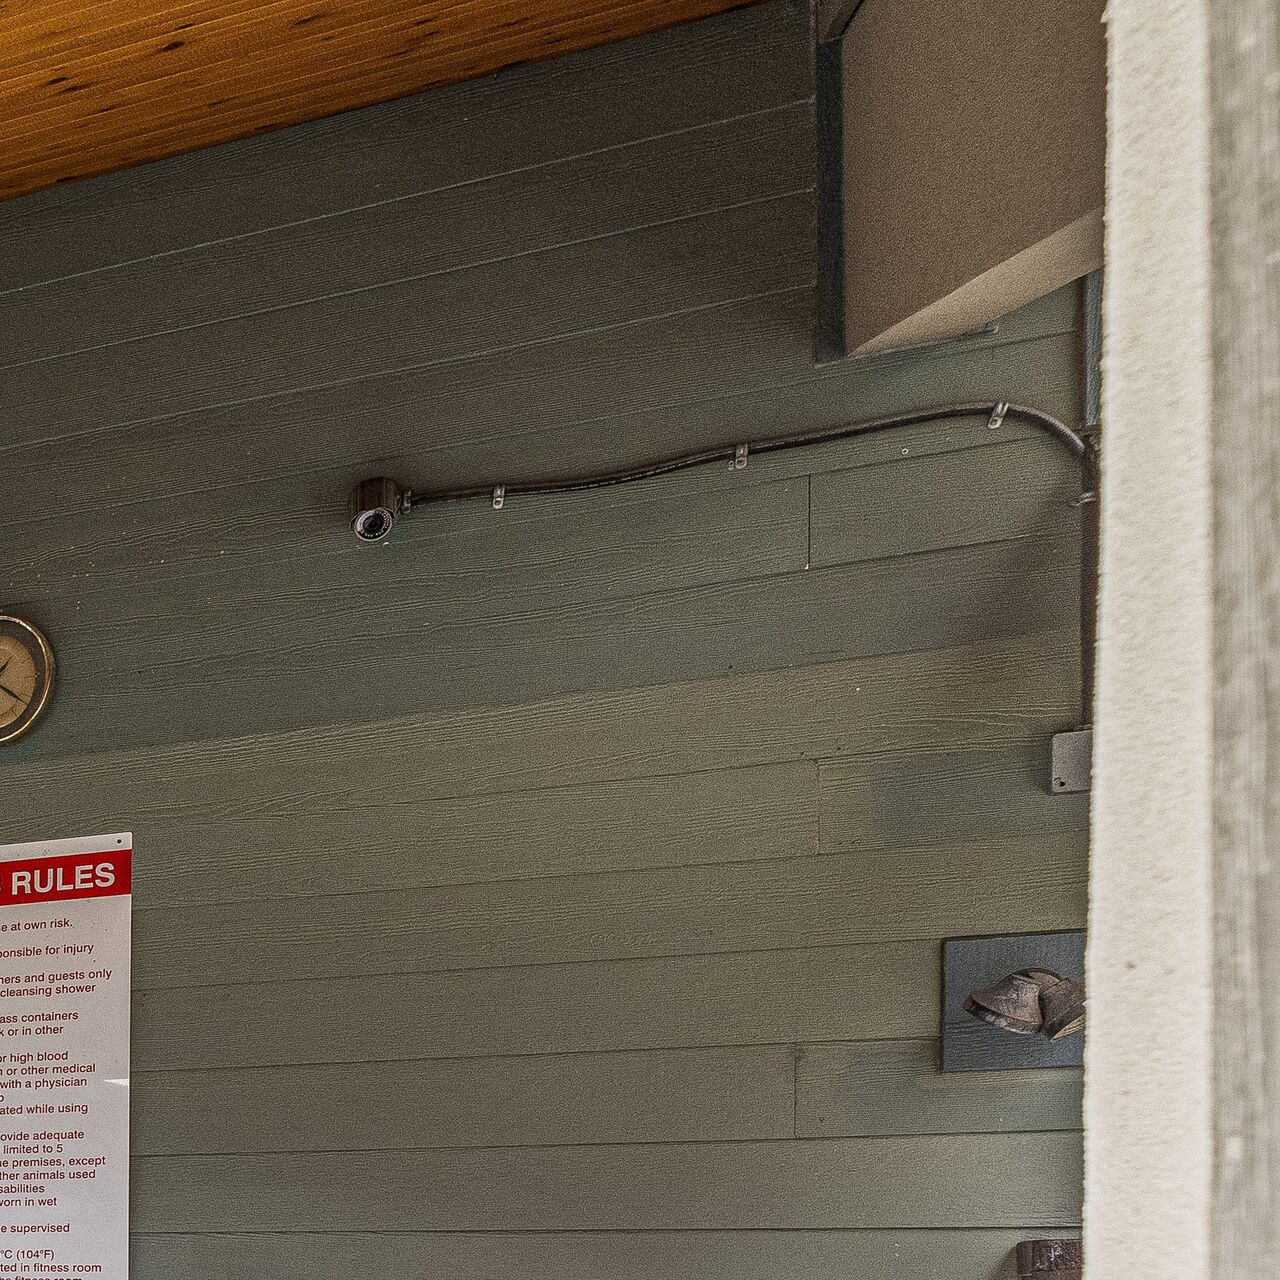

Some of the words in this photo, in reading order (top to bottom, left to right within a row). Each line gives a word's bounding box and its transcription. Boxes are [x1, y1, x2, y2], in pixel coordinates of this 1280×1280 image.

[11, 862, 115, 895] RULES
[10, 921, 21, 931] at
[23, 921, 47, 930] own
[50, 917, 74, 929] risk.
[45, 945, 60, 955] for
[63, 943, 94, 955] injury
[24, 972, 44, 983] and
[48, 970, 85, 984] guests
[88, 968, 112, 980] only
[0, 985, 52, 998] cleansing
[55, 984, 96, 994] shower
[21, 1011, 78, 1022] containers
[10, 1052, 33, 1064] high
[37, 1050, 68, 1061] blood
[6, 1067, 18, 1076] or
[20, 1065, 49, 1075] other
[52, 1062, 95, 1074] medical
[26, 1103, 55, 1114] while
[57, 1102, 88, 1115] using
[32, 1130, 84, 1142] adequate
[12, 1156, 65, 1169] premises,
[68, 1155, 106, 1167] except
[24, 1196, 34, 1206] in
[37, 1197, 57, 1206] wet
[10, 1222, 70, 1235] supervised
[20, 1262, 30, 1272] in
[33, 1262, 69, 1272] fitness
[72, 1264, 102, 1272] room
